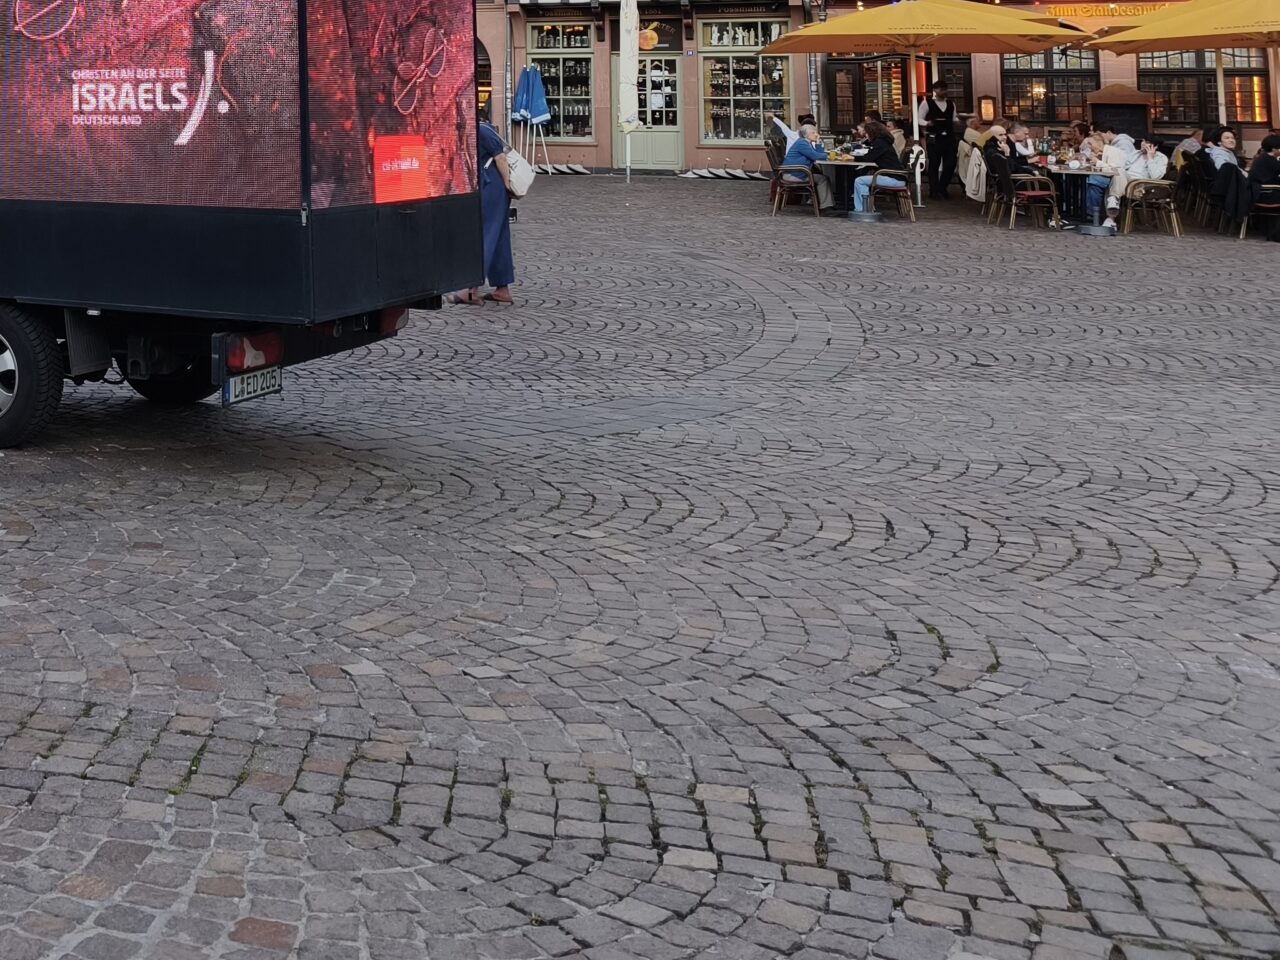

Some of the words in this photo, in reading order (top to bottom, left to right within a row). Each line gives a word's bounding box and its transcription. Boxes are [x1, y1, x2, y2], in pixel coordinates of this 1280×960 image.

[72, 81, 189, 112] ISRAELS
[72, 115, 142, 126] DEUTSCHLAND
[233, 379, 240, 399] L
[246, 374, 258, 395] ED
